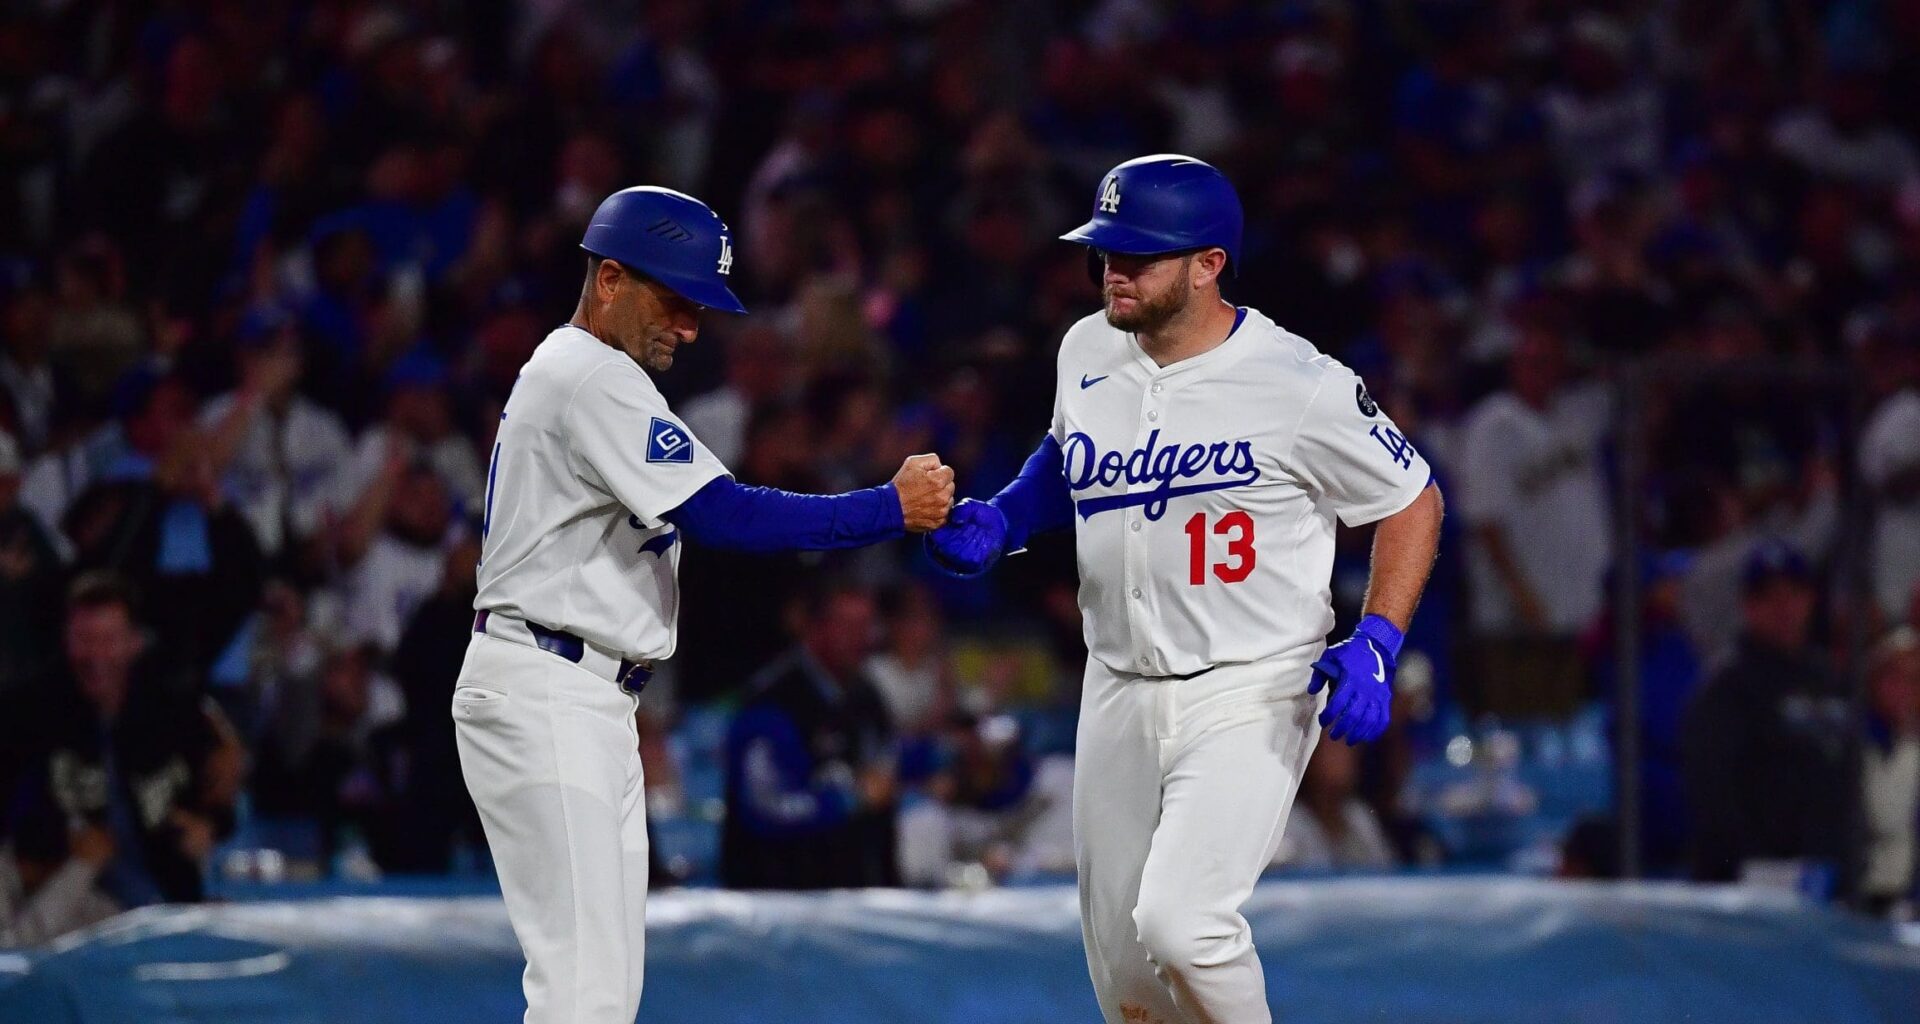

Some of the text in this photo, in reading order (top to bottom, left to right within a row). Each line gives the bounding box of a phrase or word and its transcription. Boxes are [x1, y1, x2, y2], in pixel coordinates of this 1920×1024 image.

[1100, 175, 1120, 213] LA
[717, 235, 733, 275] LA
[1369, 424, 1414, 470] LA
[1065, 429, 1260, 523] Dodgers
[1185, 511, 1256, 585] 13
